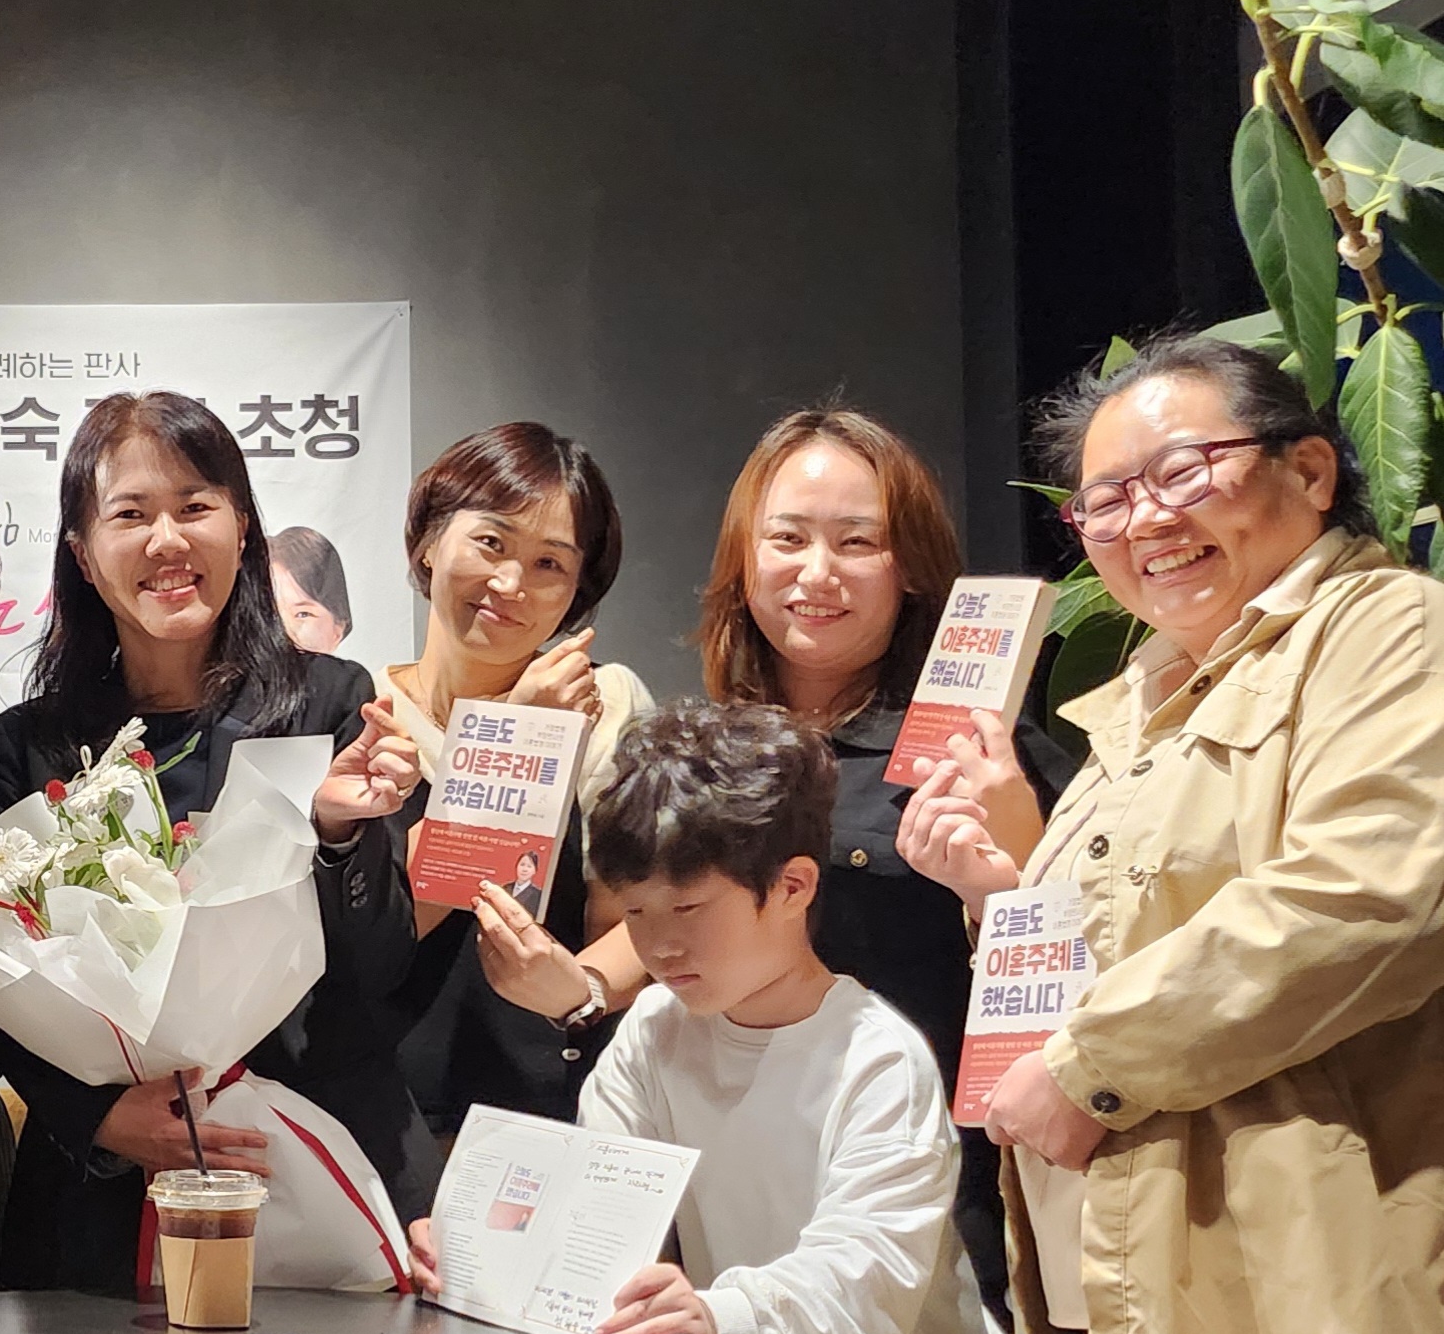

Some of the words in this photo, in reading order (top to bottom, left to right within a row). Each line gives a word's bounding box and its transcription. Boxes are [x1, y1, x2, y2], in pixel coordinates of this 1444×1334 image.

[83, 351, 141, 379] 판사
[237, 393, 360, 460] 초청
[950, 592, 990, 618] 오늘도
[940, 625, 1014, 657] 이혼주례를
[926, 658, 986, 690] 했습니다
[458, 713, 516, 744] 오늘도
[452, 747, 559, 786] 이혼주례를
[441, 778, 527, 816] 했습니다
[990, 903, 1043, 939] 오늘도
[986, 936, 1086, 977] 이혼주례를
[980, 982, 1064, 1017] 했습니다
